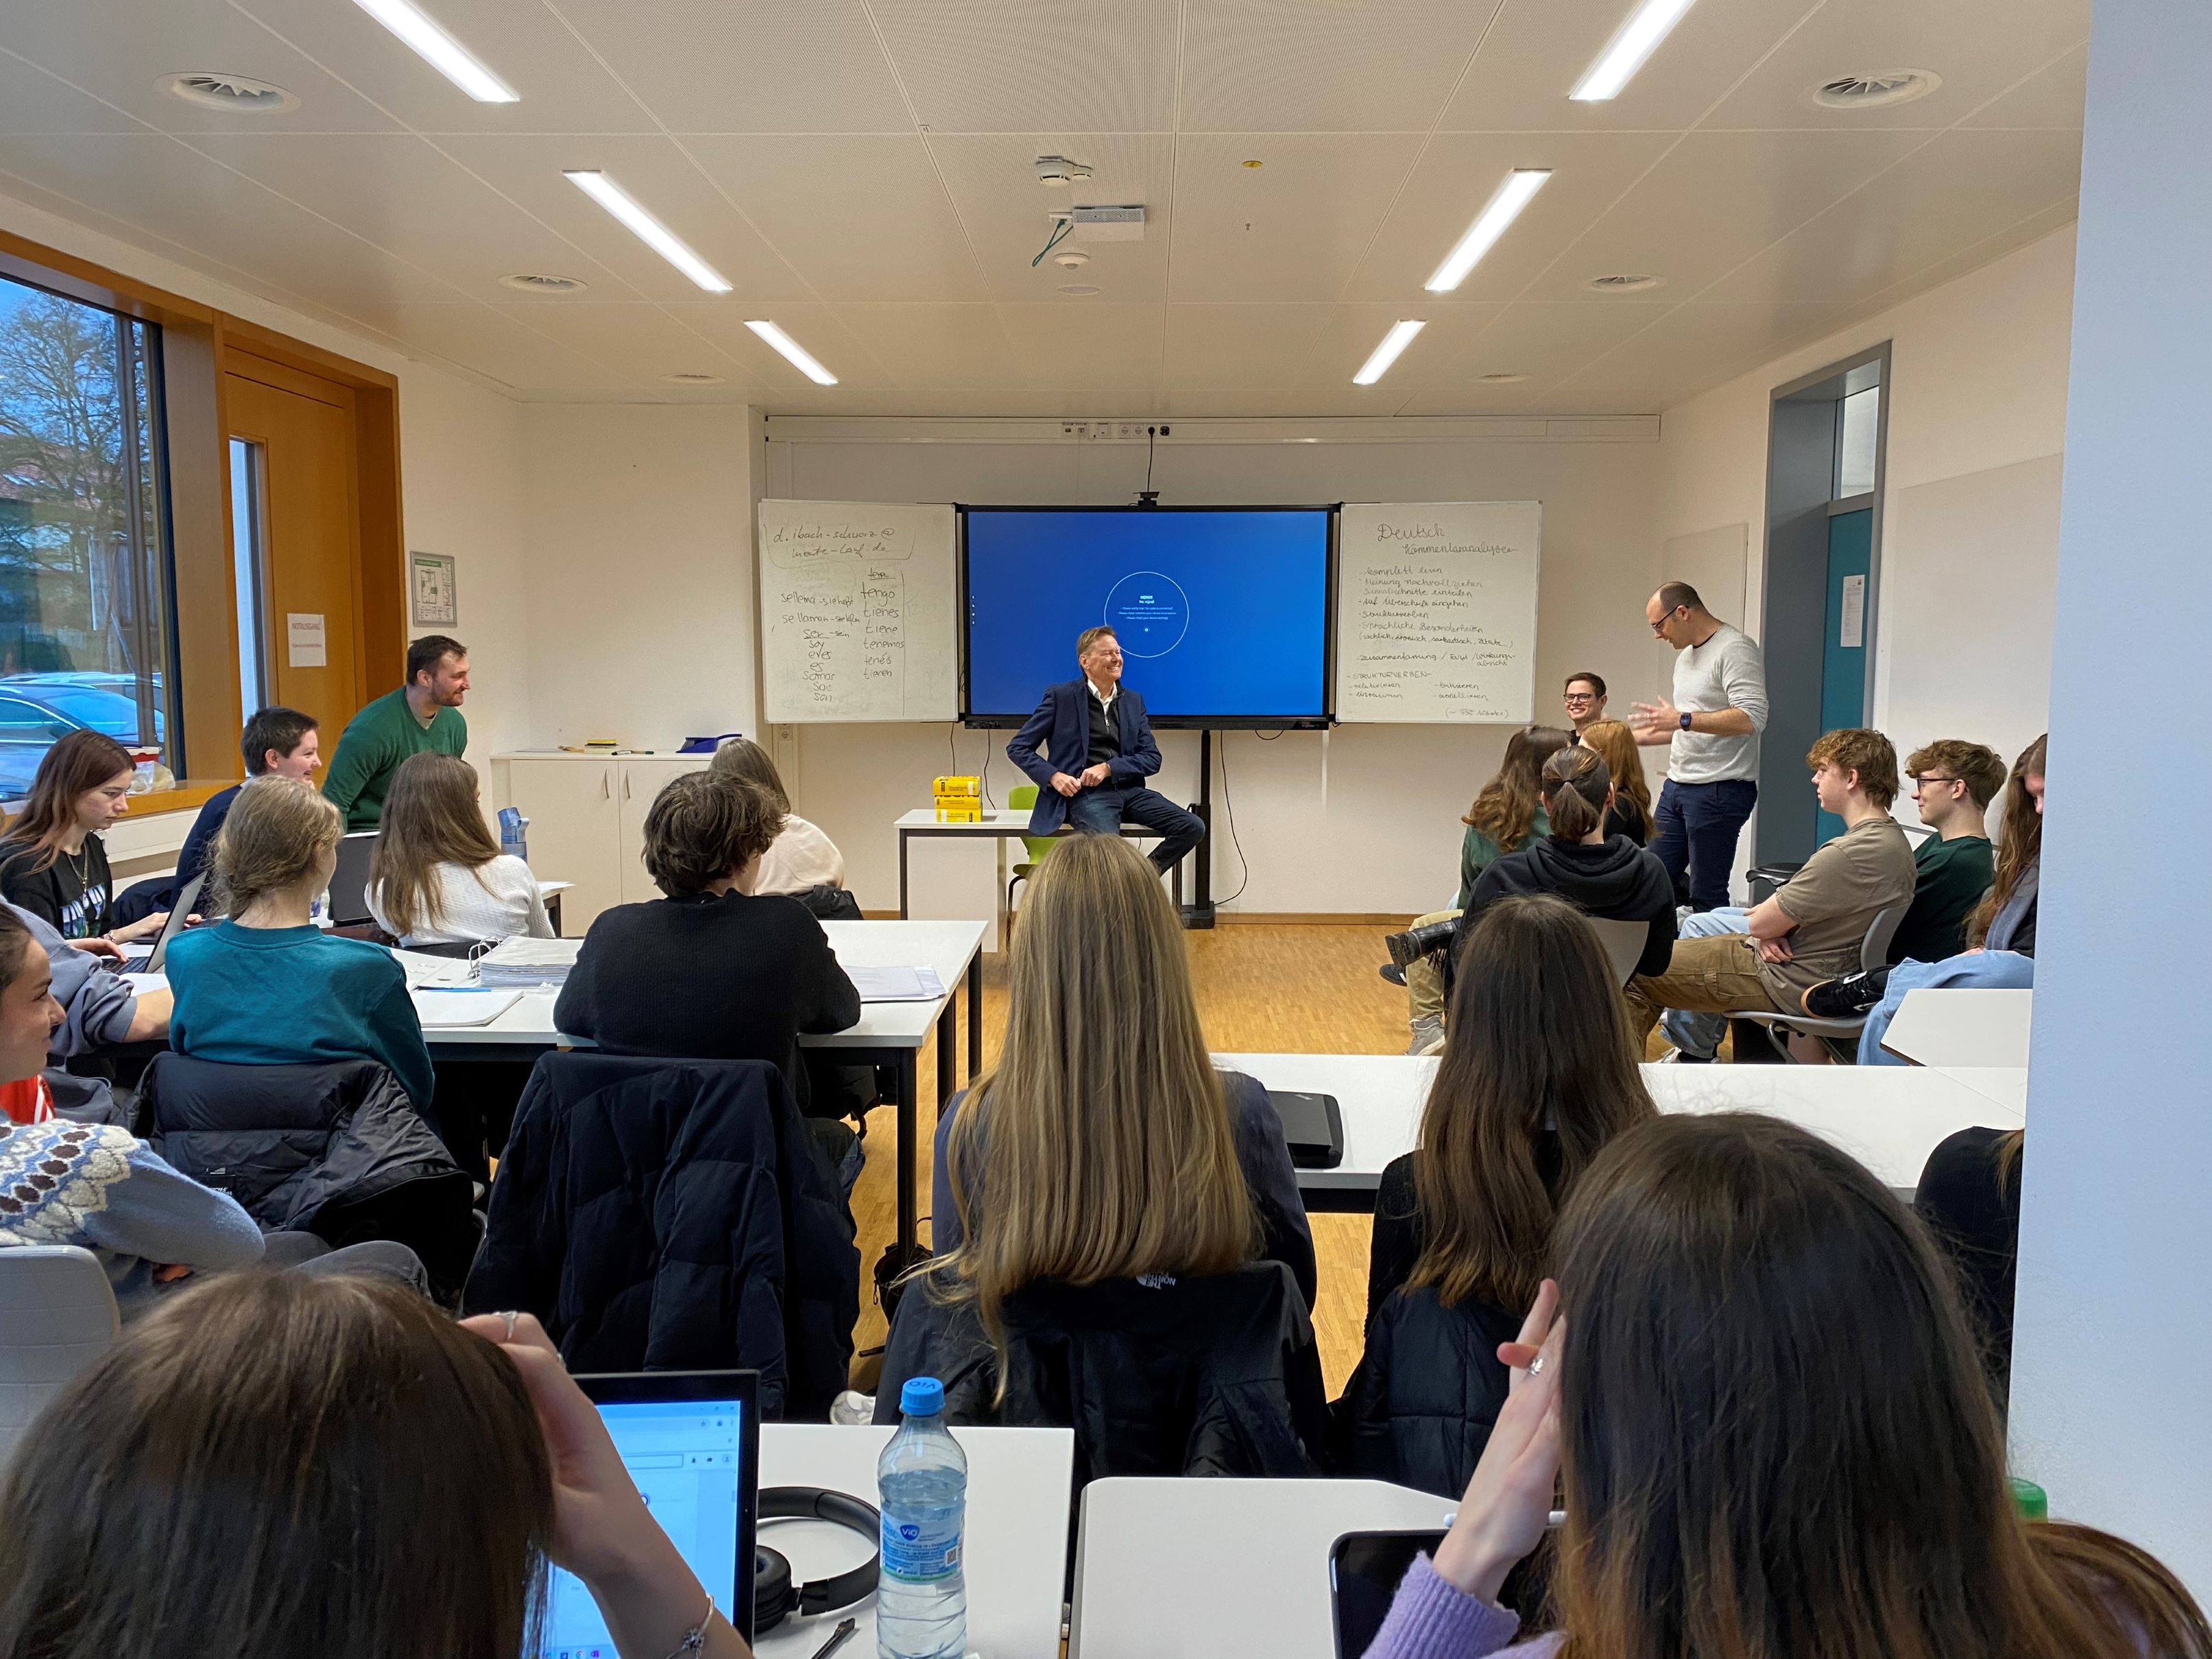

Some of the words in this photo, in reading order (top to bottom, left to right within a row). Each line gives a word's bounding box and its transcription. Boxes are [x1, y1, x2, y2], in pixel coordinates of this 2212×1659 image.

[1377, 523, 1445, 542] Deutsch
[861, 582, 895, 607] tengo
[863, 601, 900, 618] tienes
[865, 619, 898, 634] tiene
[863, 638, 905, 650] tenemos
